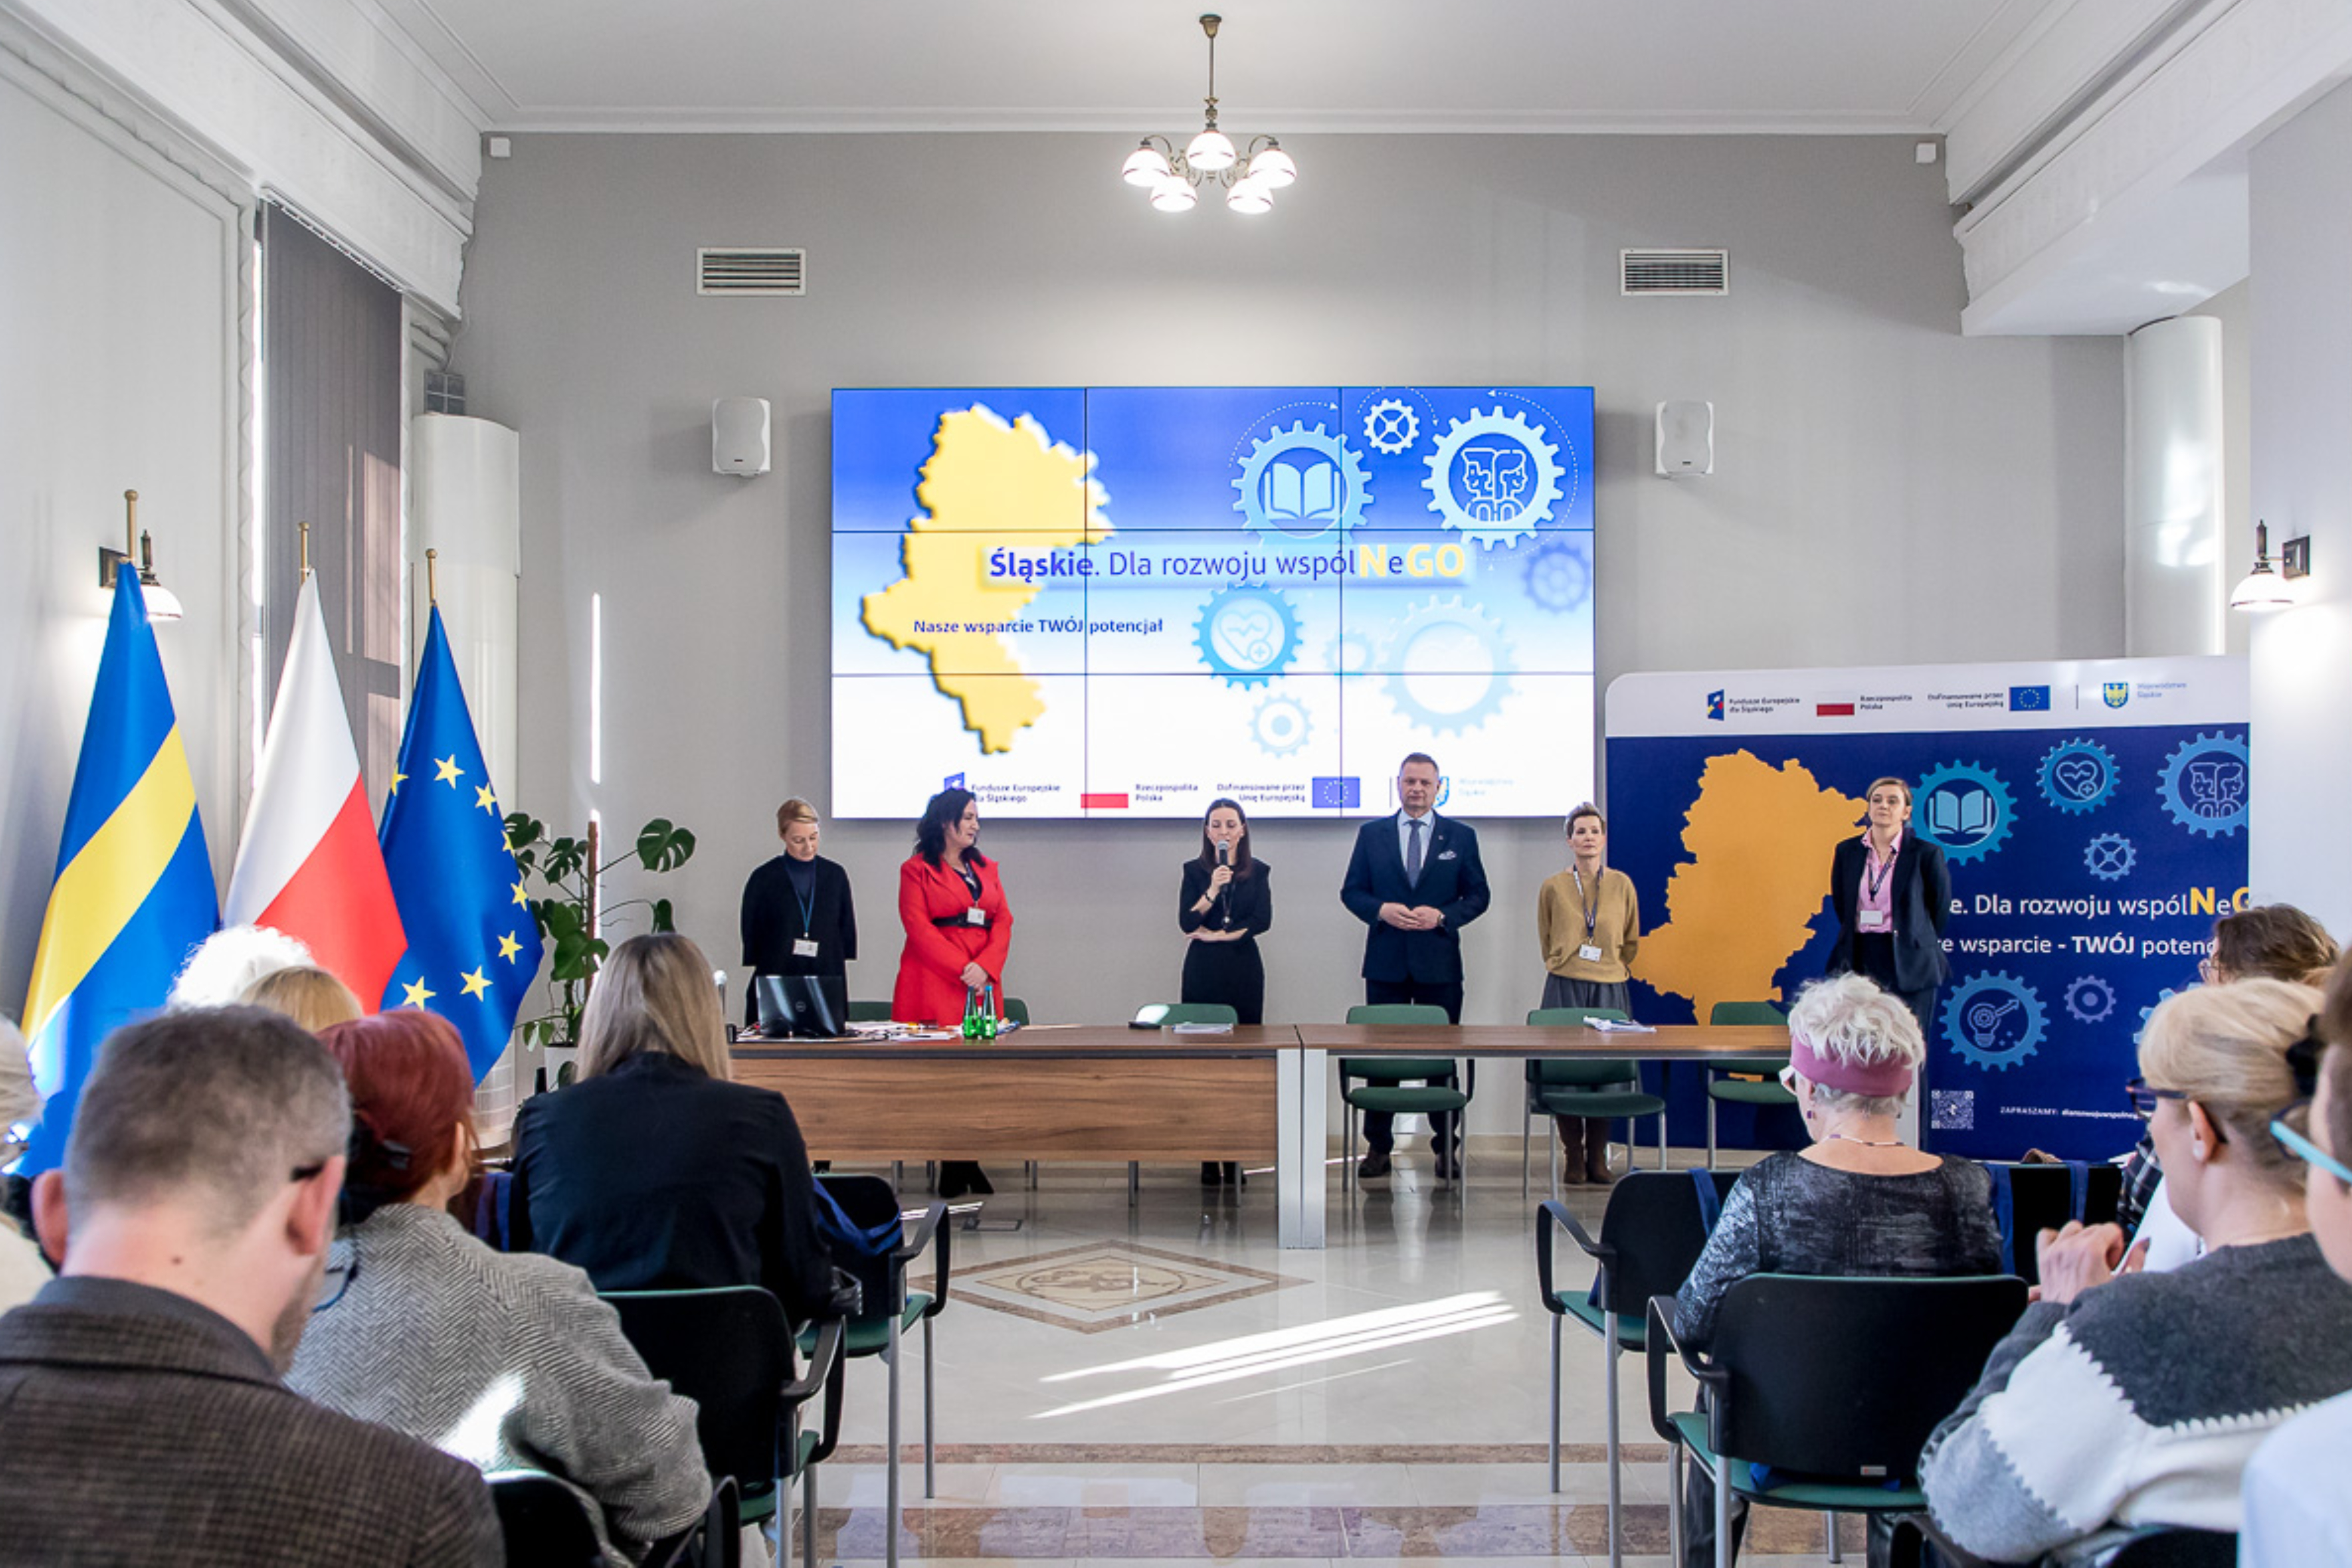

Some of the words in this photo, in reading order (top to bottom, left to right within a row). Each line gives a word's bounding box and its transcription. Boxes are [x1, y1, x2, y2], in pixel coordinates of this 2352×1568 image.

[990, 547, 1099, 582] Śląskie.
[1110, 551, 1151, 575] Dla
[1163, 551, 1267, 581] rozwoju
[914, 620, 959, 633] Nasze
[964, 618, 1034, 634] wsparcie
[1039, 615, 1083, 633] TWÓJ
[1090, 619, 1162, 635] potencjał
[1976, 894, 2012, 914] Dla
[2020, 894, 2110, 919] rozwoju
[2117, 886, 2249, 919] wspólNeG
[1959, 935, 2052, 956] wsparcie
[2071, 932, 2134, 953] TWÓJ
[2142, 938, 2215, 959] potenc
